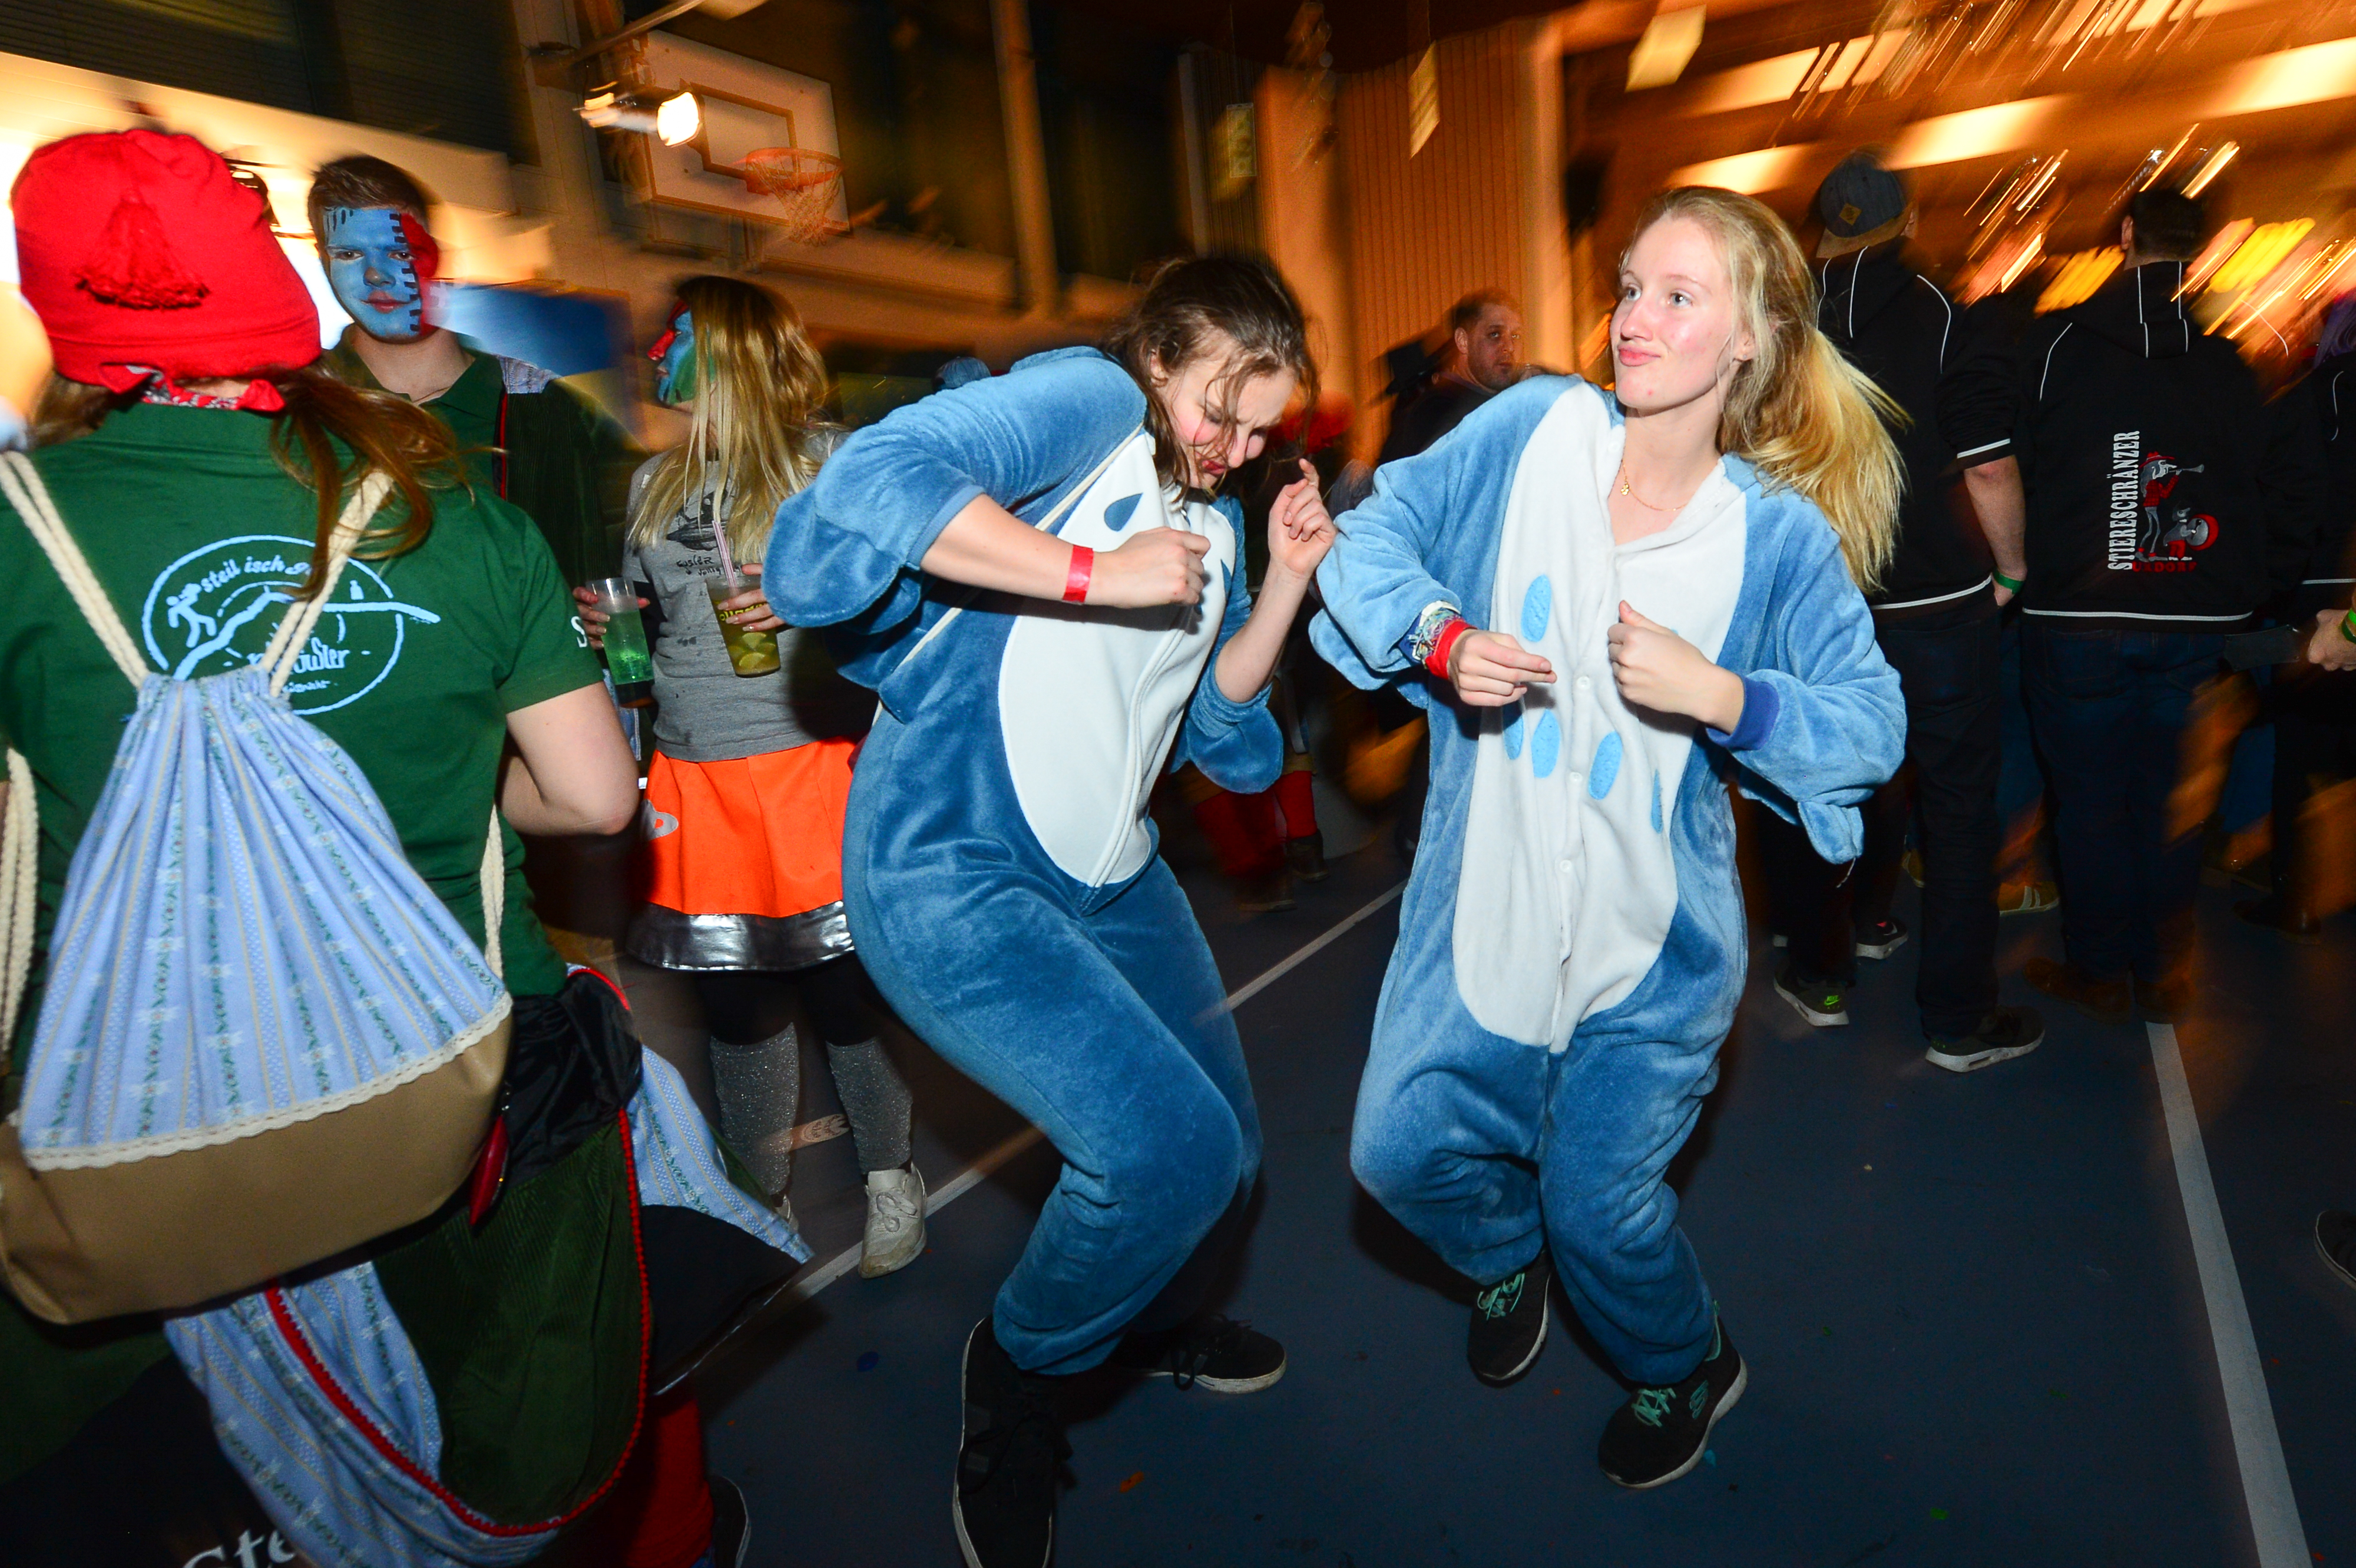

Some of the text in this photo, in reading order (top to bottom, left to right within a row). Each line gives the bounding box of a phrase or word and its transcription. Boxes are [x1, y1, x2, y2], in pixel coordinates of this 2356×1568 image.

[2106, 431, 2140, 570] STIERESCHRÄNZER
[201, 558, 241, 593] steil
[244, 555, 286, 573] isch
